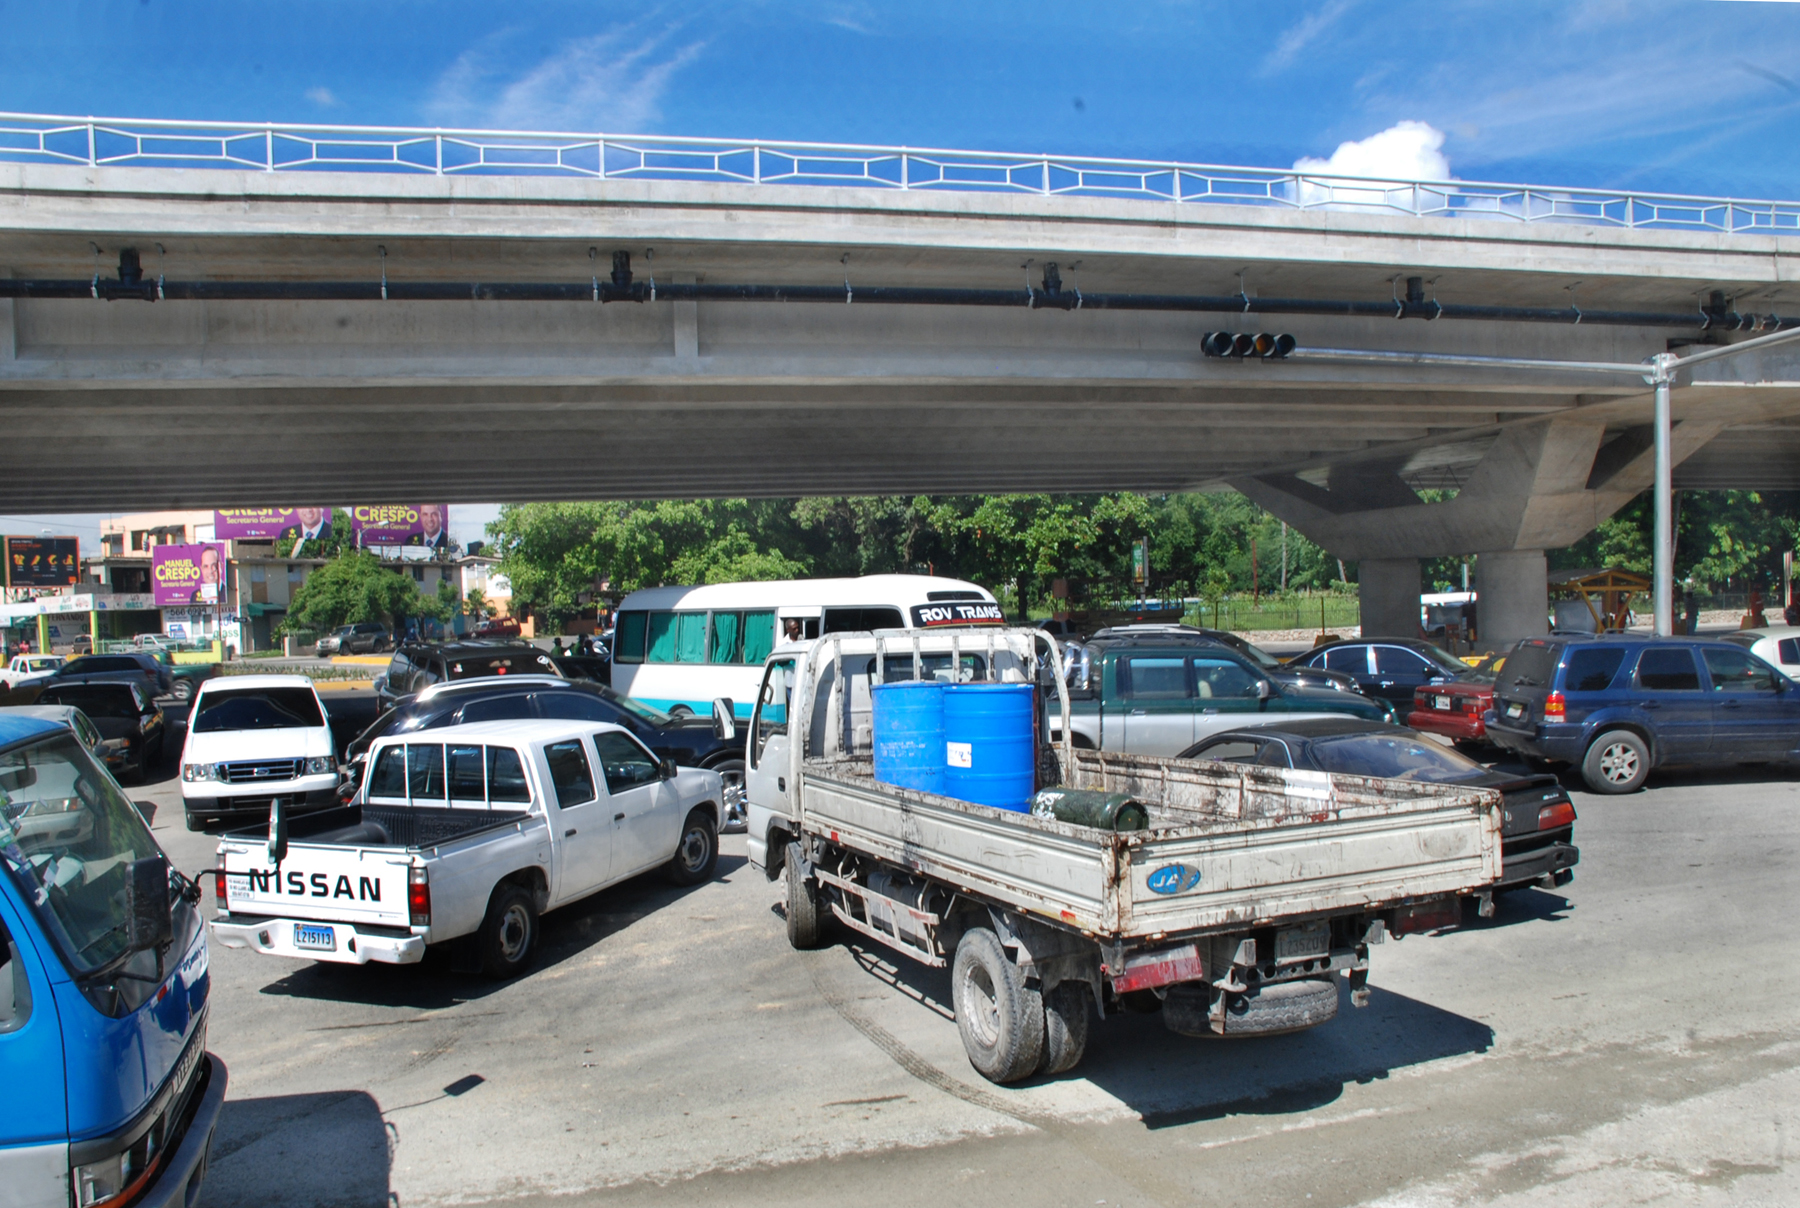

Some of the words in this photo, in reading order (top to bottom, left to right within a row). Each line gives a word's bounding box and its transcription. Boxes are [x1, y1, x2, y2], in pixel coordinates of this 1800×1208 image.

[226, 516, 259, 524] Secretario
[259, 516, 285, 524] General
[354, 506, 418, 523] CRESPO
[390, 522, 411, 530] General
[164, 559, 194, 568] MANUEL
[155, 564, 201, 581] CRESPO
[919, 607, 952, 622] ROV
[956, 605, 1002, 619] TRANS
[249, 868, 382, 902] NISSAN
[296, 930, 331, 945] L215113
